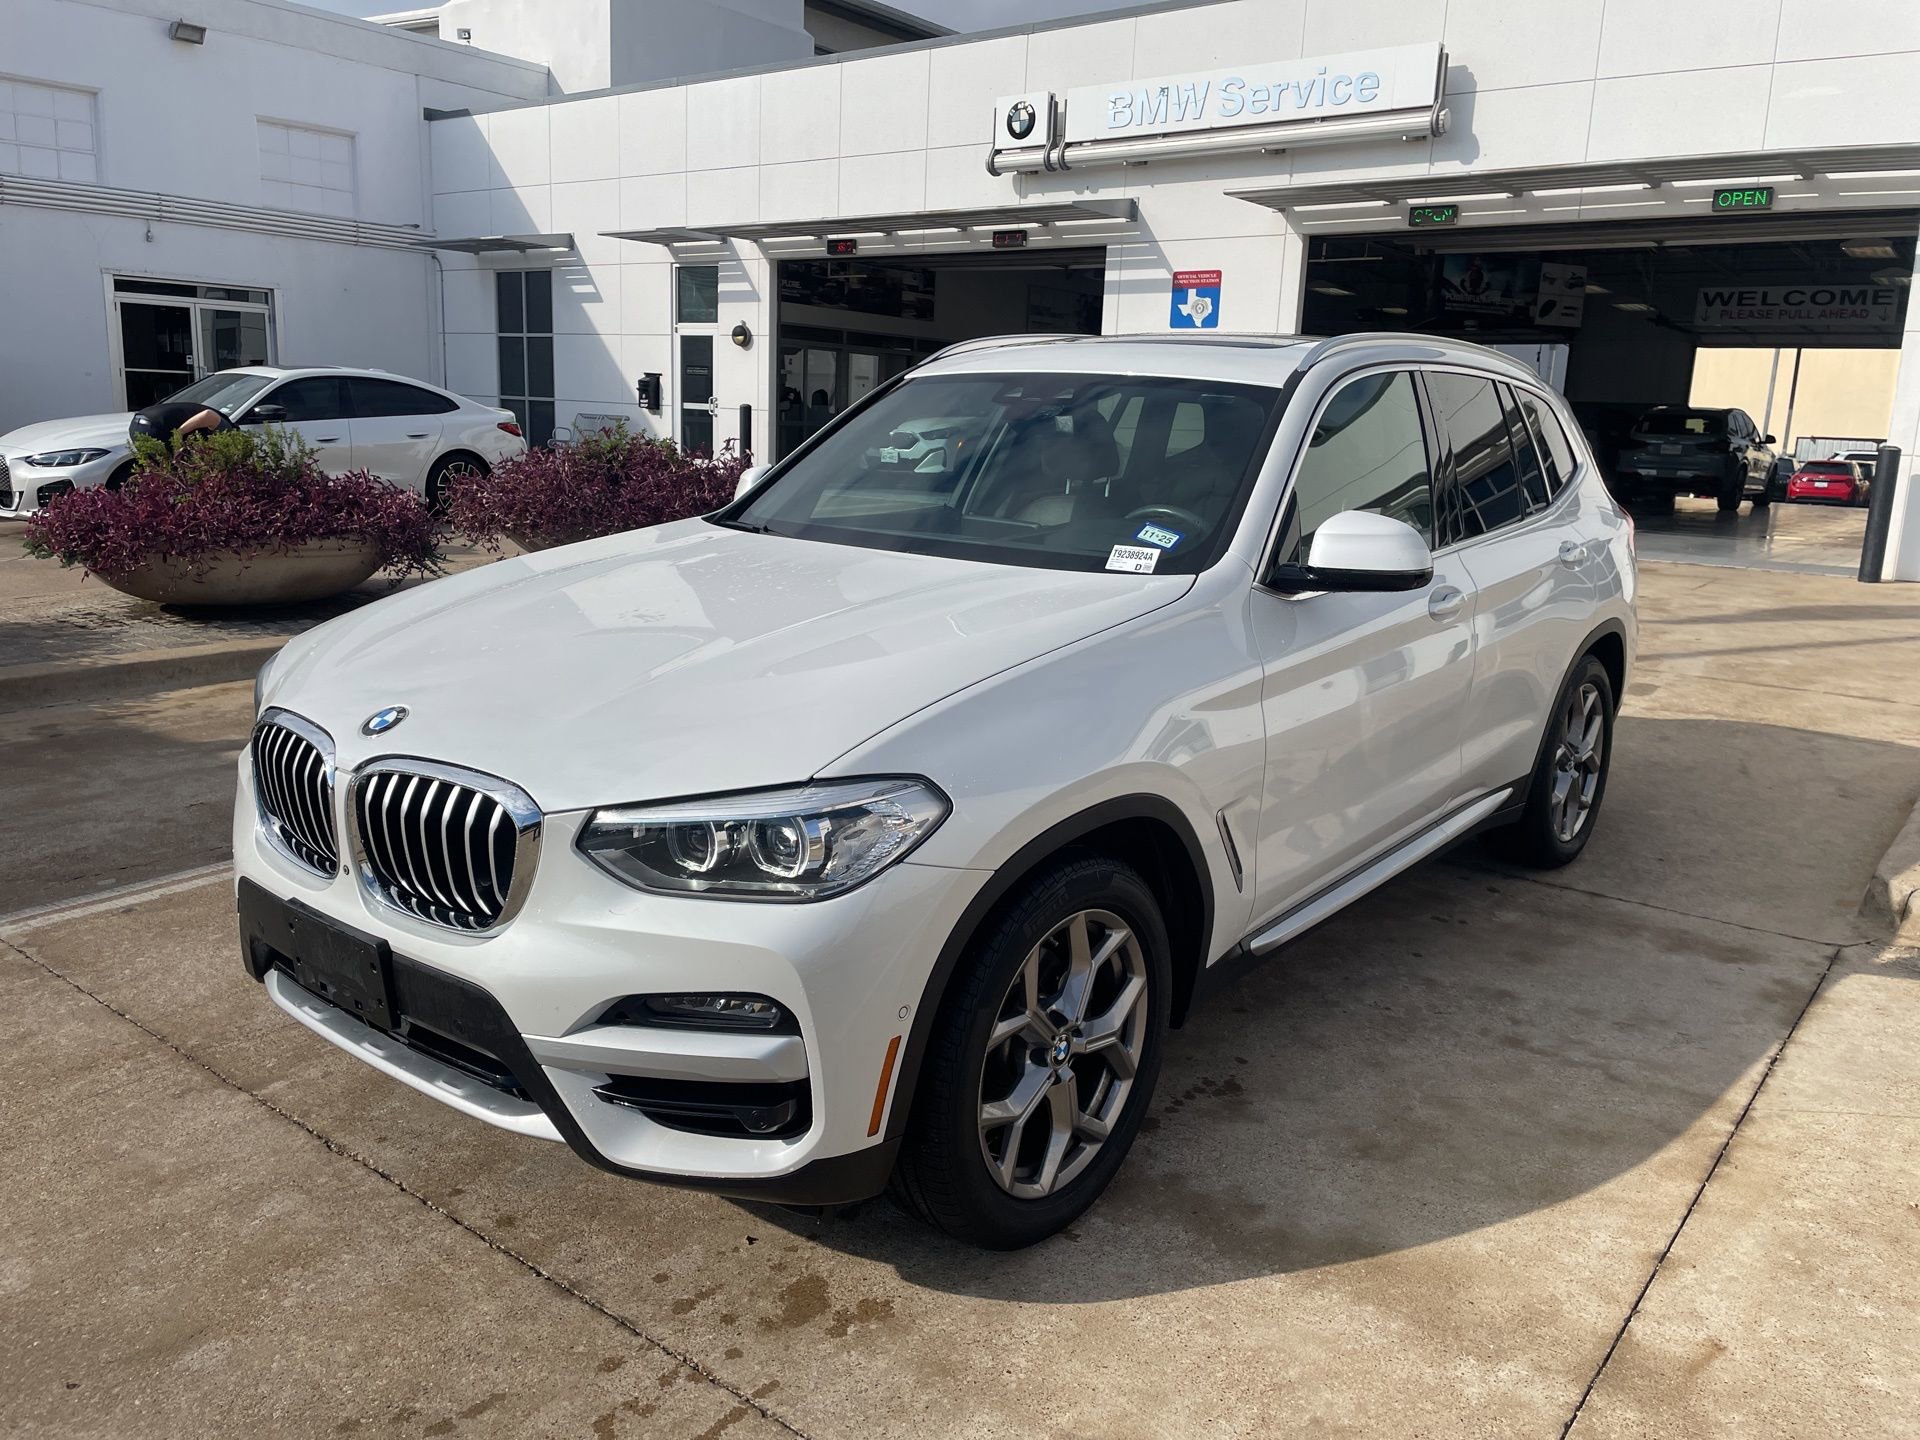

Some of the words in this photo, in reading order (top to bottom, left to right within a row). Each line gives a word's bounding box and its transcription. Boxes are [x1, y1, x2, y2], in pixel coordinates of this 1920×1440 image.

[1107, 80, 1211, 130] BMW
[1216, 66, 1381, 118] Service
[1718, 190, 1767, 207] OPEN
[1702, 288, 1895, 307] WELCOME
[1719, 308, 1774, 321] PLEASE
[1778, 308, 1814, 320] PULL
[1818, 308, 1870, 320] AHEAD
[1113, 549, 1153, 561] T9238924A
[1134, 563, 1142, 571] D
